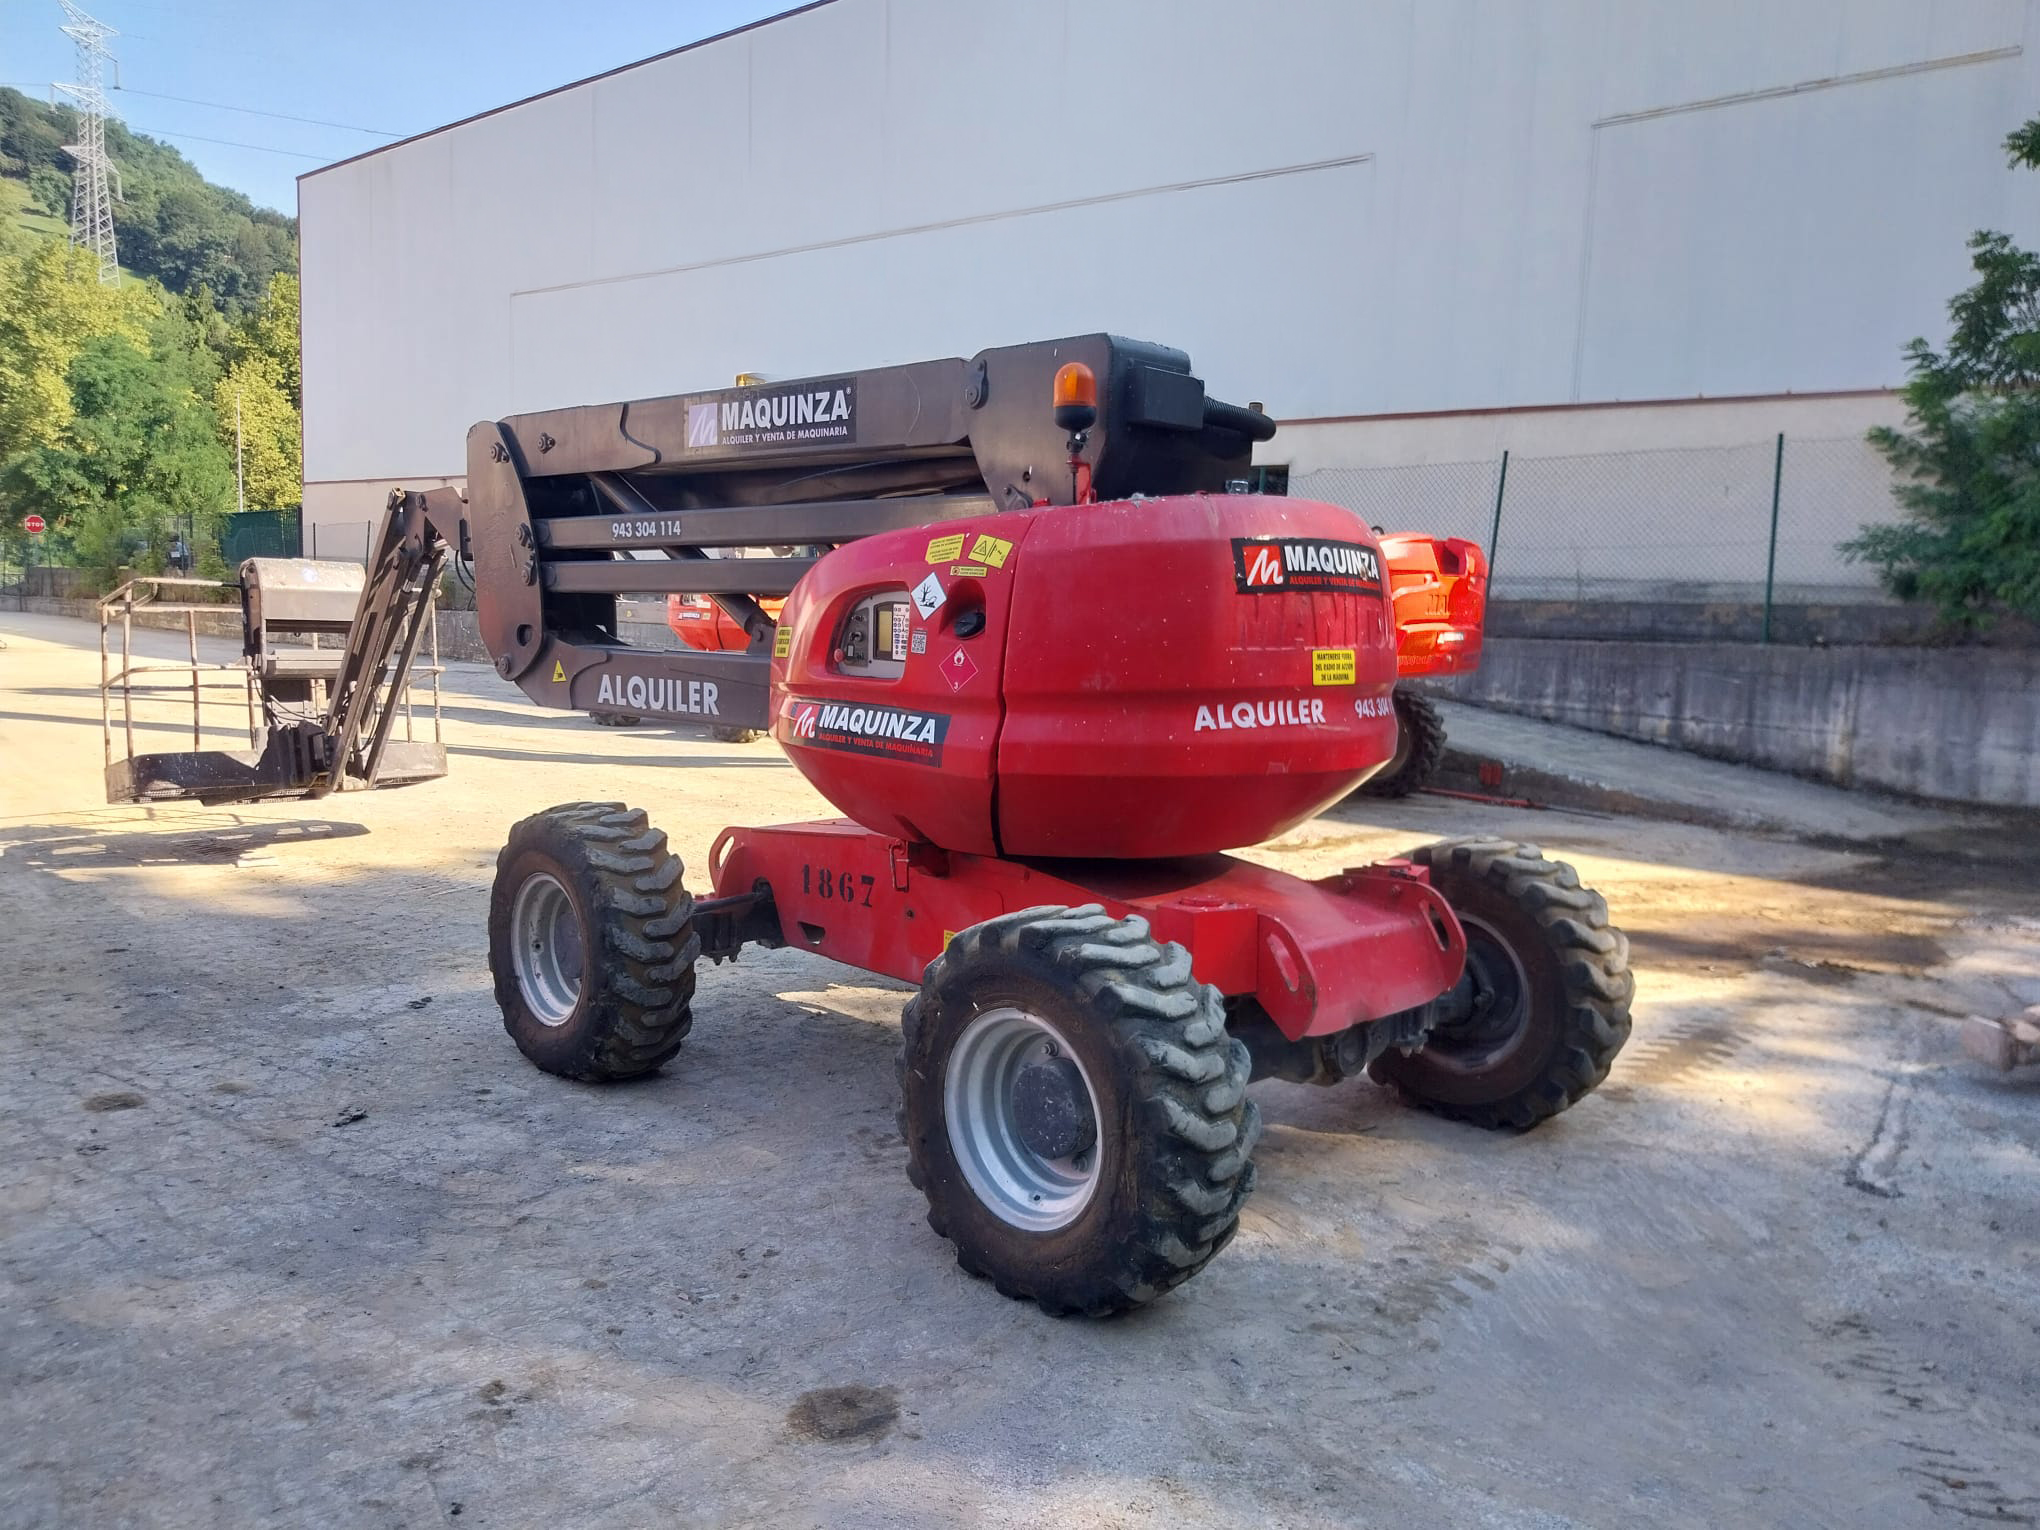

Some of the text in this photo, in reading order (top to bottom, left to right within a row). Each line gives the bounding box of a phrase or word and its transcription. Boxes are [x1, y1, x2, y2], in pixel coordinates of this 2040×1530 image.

[722, 426, 848, 445] ALQUILER Y VENTA DE MAQUINARIA
[612, 520, 681, 538] 943 304 114
[1284, 545, 1380, 580] MAQUINZA
[597, 674, 720, 715] ALQUILER
[1354, 698, 1376, 719] 943
[818, 705, 936, 744] MAQUINZA
[1194, 698, 1326, 732] ALQUILER
[818, 733, 933, 757] ALQUILER Y VENTA DE MAQUINARIA
[803, 864, 875, 907] 1867
